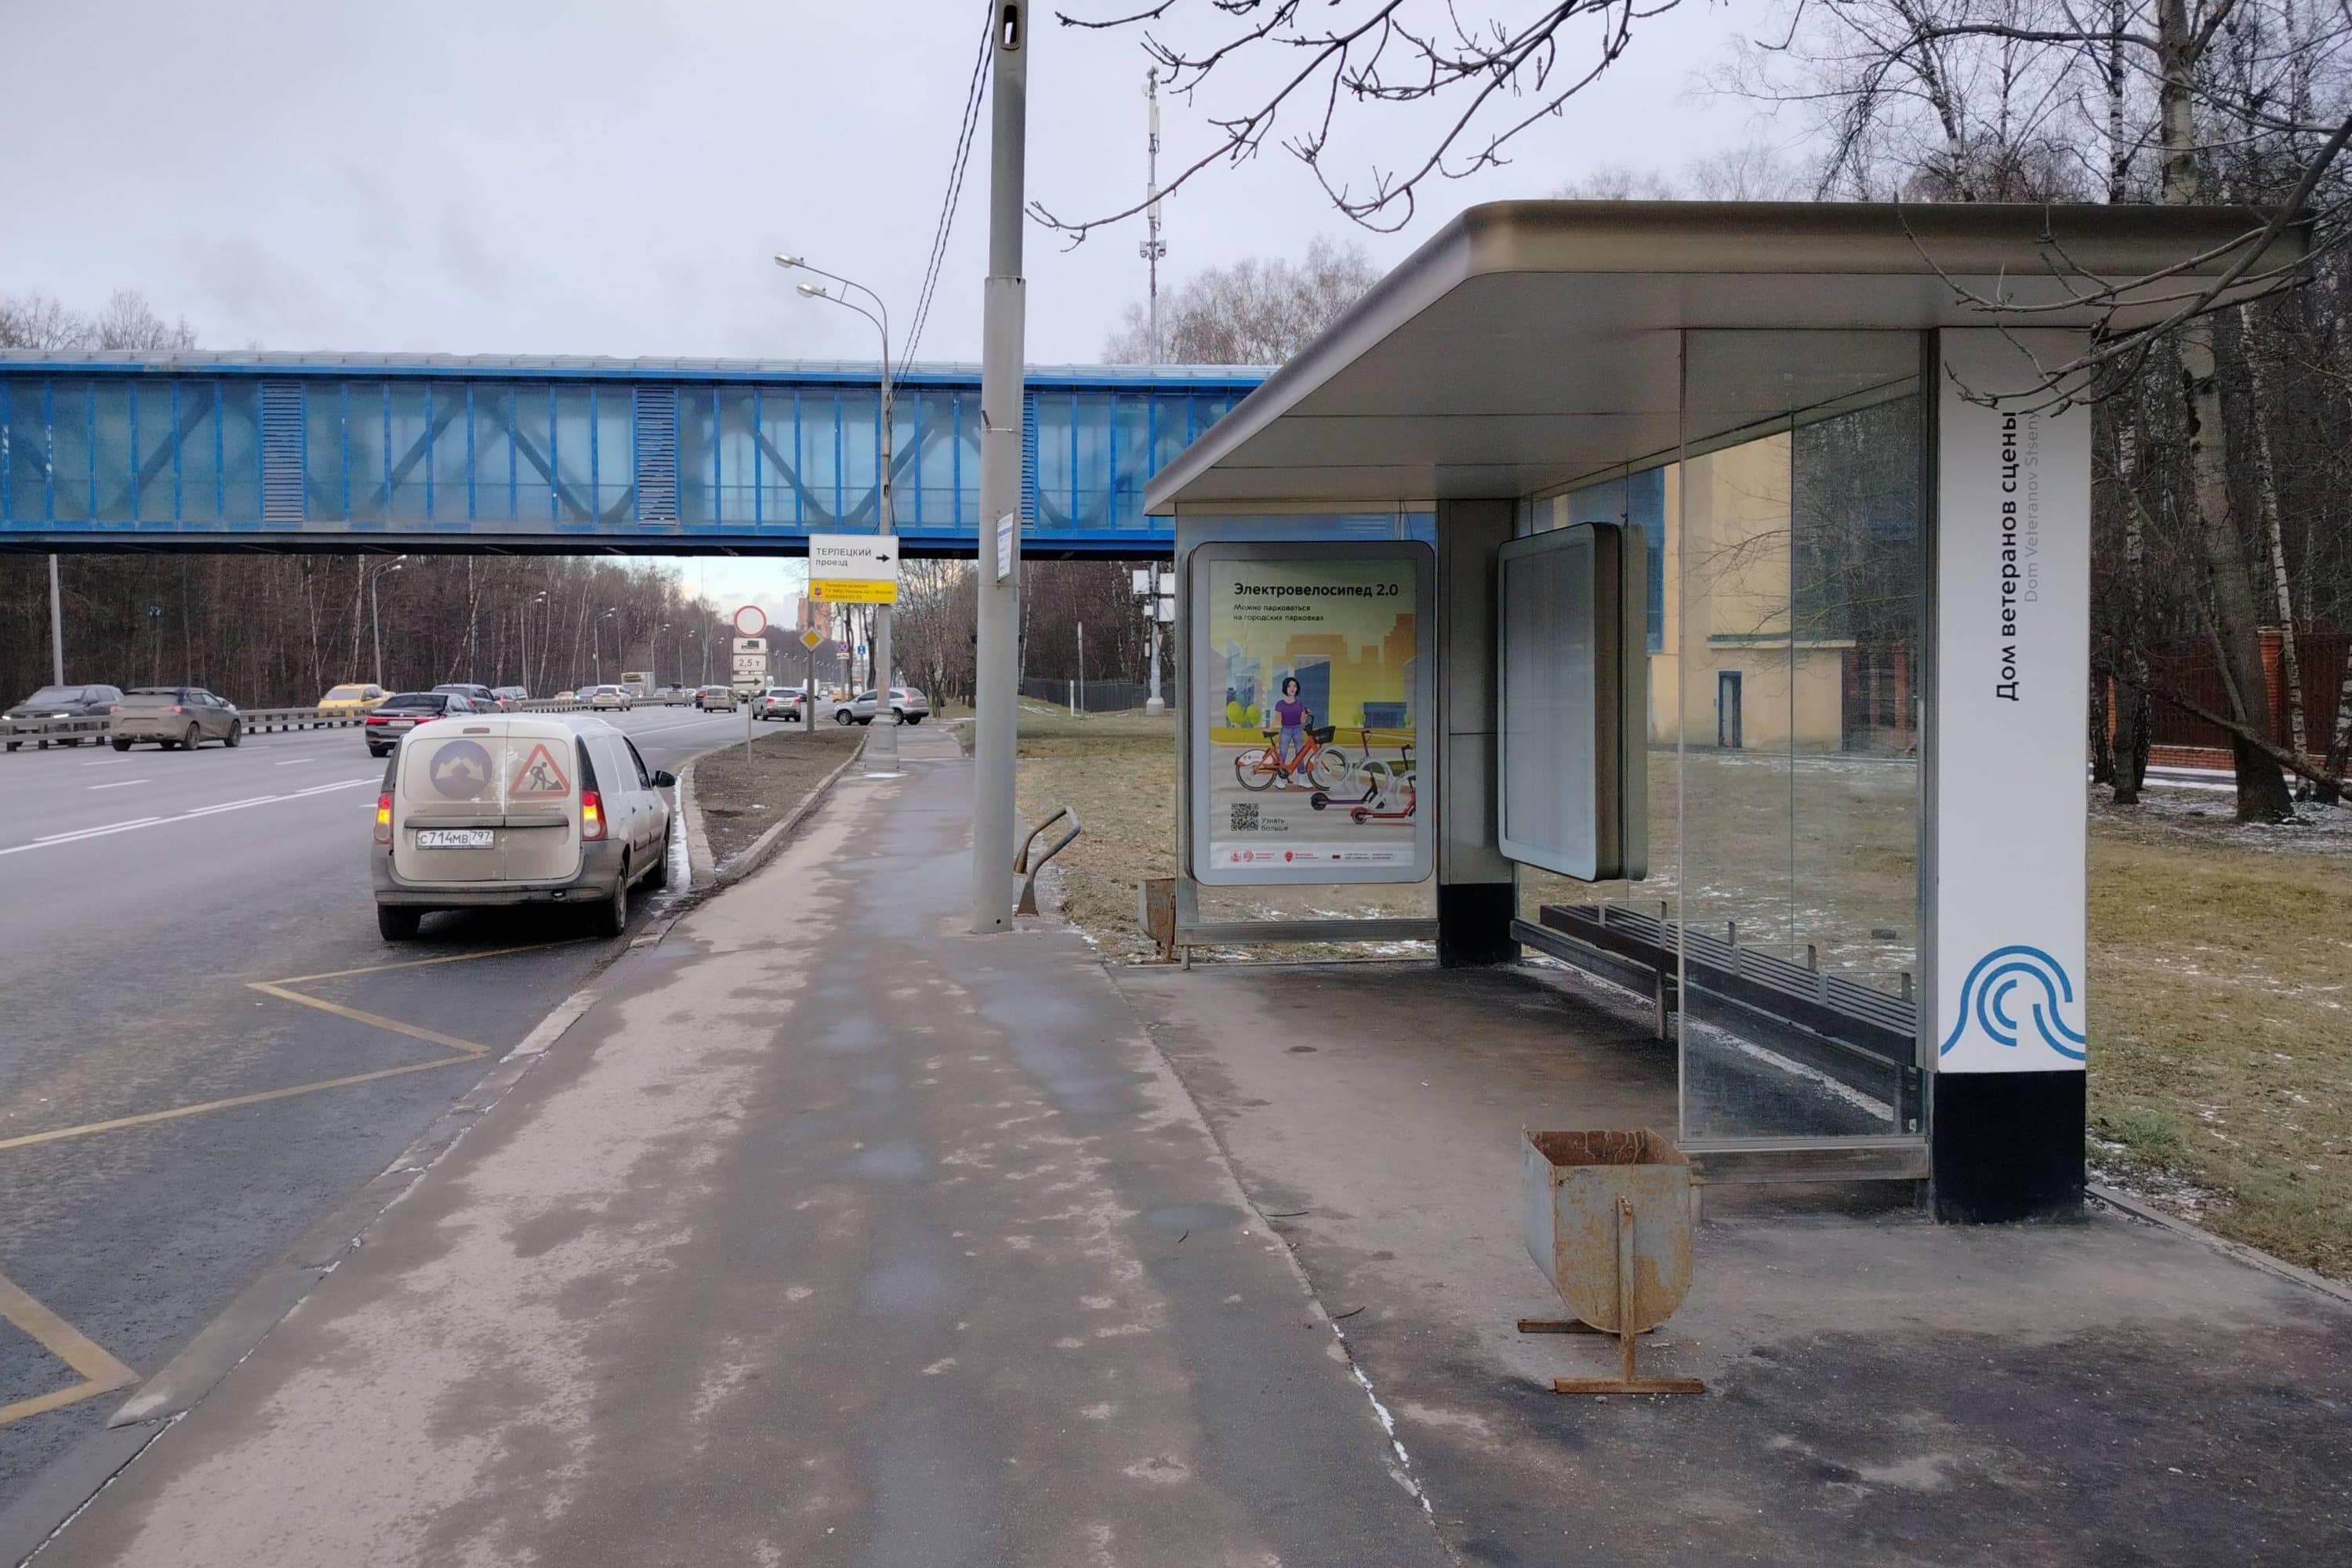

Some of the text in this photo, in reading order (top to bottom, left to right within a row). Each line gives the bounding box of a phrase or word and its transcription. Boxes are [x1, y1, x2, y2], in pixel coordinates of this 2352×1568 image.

[2024, 412, 2041, 602] Dom Veteranov Stseny
[815, 547, 872, 557] ТЕРЛЕЦКИЙ
[1996, 412, 2020, 702] Дом ветеранов сцены
[1234, 583, 1399, 598] Электровелосипед 2.0
[739, 659, 753, 667] 2,5
[420, 831, 491, 844] С714МВ 797
